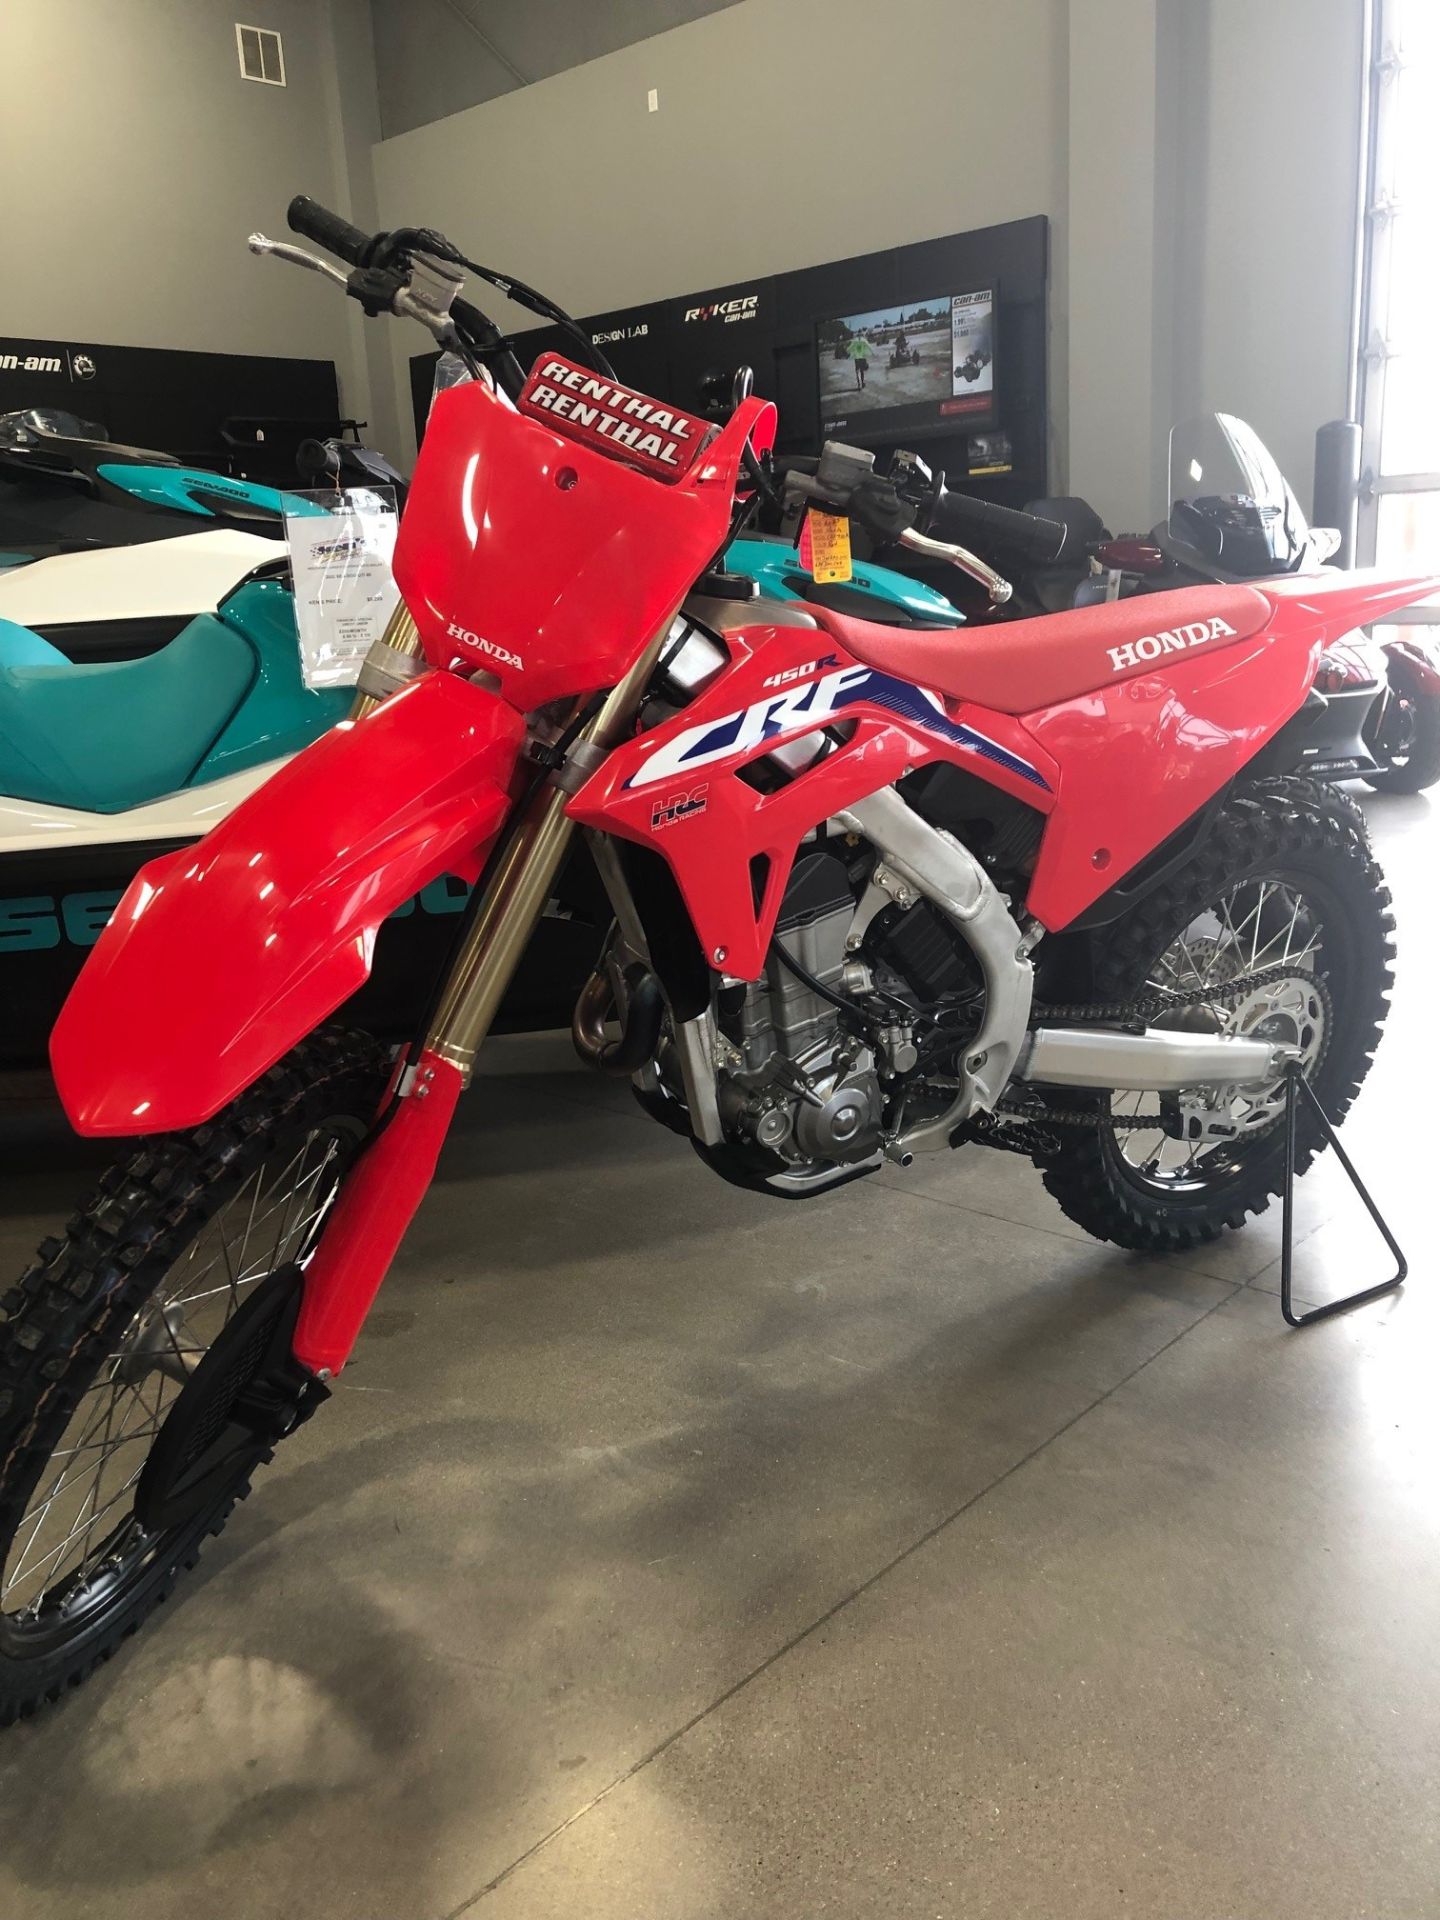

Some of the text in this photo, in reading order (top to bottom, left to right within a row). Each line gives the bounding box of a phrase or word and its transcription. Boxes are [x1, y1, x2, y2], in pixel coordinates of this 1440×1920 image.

[685, 295, 758, 322] RYKER
[724, 310, 756, 323] can-am
[953, 292, 990, 306] can-am
[592, 324, 648, 345] DESIGN LAB
[0, 355, 61, 372] n-am
[541, 361, 691, 439] RENTHAL
[530, 384, 678, 465] RENTHAL
[447, 623, 524, 671] HONDA
[1106, 617, 1237, 671] HONDA
[762, 654, 843, 688] 450R
[629, 664, 872, 788] CRF
[651, 783, 709, 828] HRC
